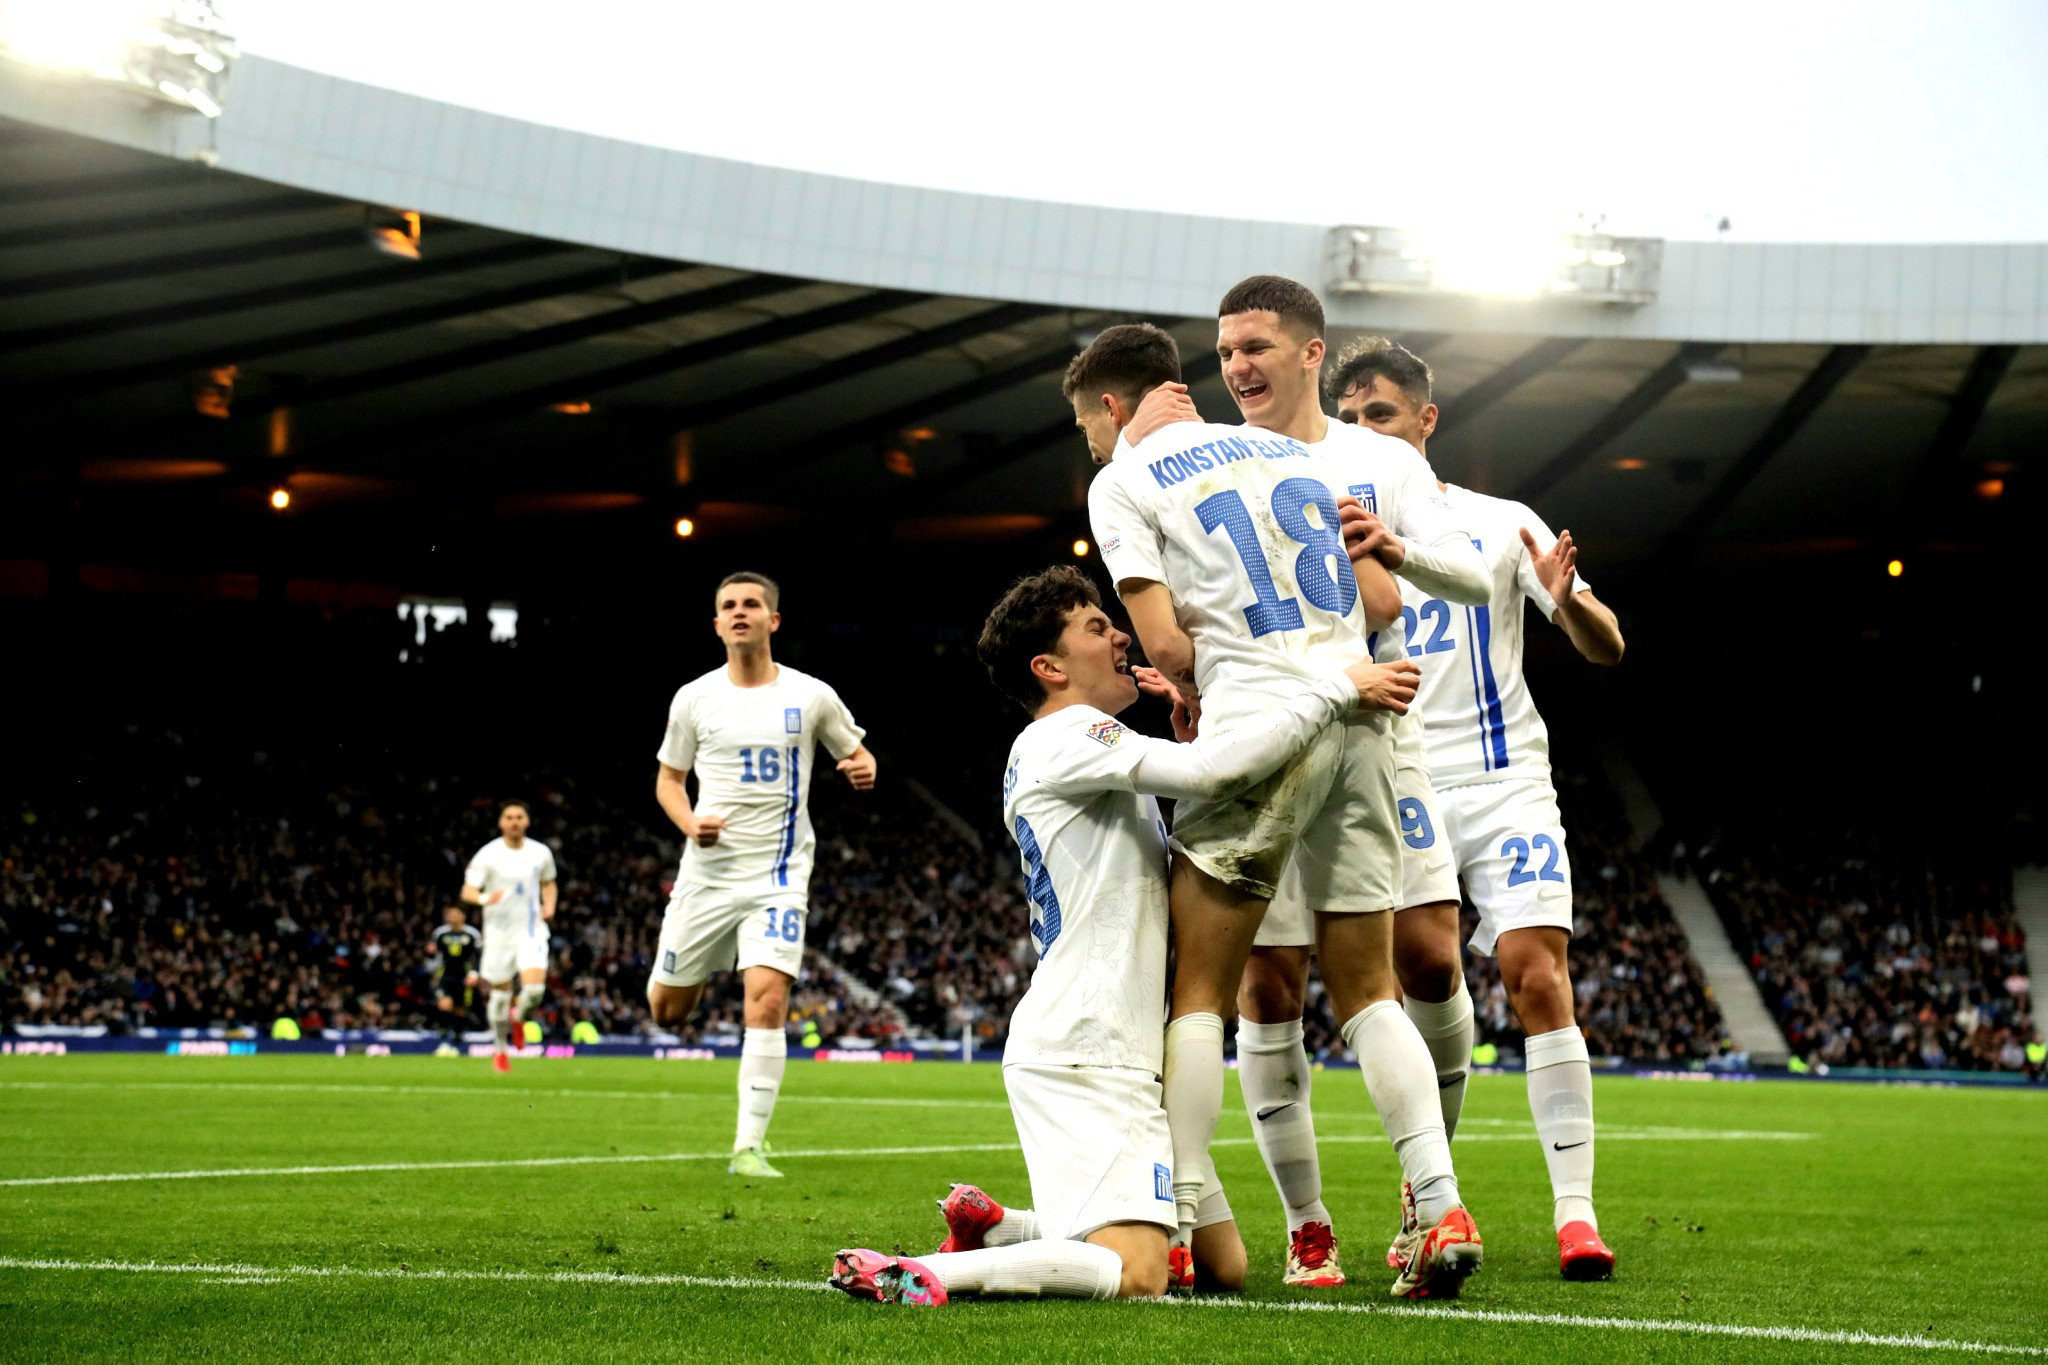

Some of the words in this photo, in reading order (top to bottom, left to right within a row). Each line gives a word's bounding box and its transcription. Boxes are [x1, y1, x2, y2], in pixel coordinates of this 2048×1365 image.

[1148, 436, 1310, 489] KONSTANELIAS
[1194, 477, 1357, 639] 18
[739, 748, 780, 783] 16
[1397, 796, 1435, 850] 9
[1501, 833, 1565, 888] 22
[764, 907, 800, 943] 16
